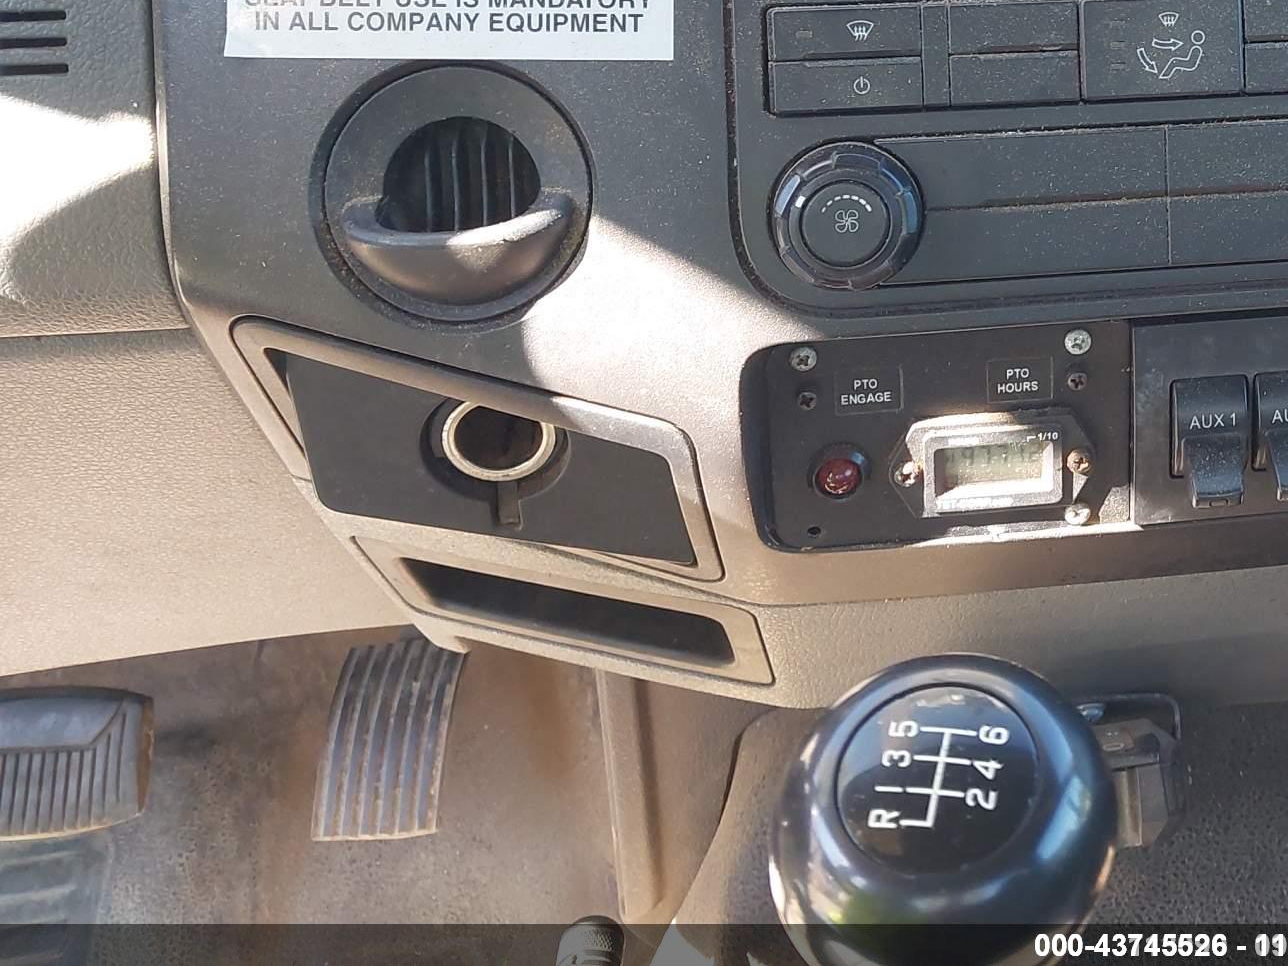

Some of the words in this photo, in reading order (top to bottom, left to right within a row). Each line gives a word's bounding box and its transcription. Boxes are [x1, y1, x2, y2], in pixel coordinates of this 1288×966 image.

[255, 11, 280, 32] IN
[289, 11, 339, 32] ALL
[347, 12, 479, 33] COMPANY
[489, 13, 644, 34] EQUIPMENT
[1006, 367, 1030, 379] PTO
[853, 378, 878, 390] PTO
[997, 380, 1039, 394] HOURS
[840, 391, 892, 406] ENGAGE
[1189, 414, 1224, 430] AUX
[1230, 412, 1237, 427] 1
[1037, 431, 1059, 442] 1/10
[887, 720, 921, 739] 5
[978, 724, 1009, 746] 6
[881, 749, 912, 768] 3
[973, 760, 1006, 781] 4
[965, 788, 999, 812] 2
[868, 808, 902, 830] R
